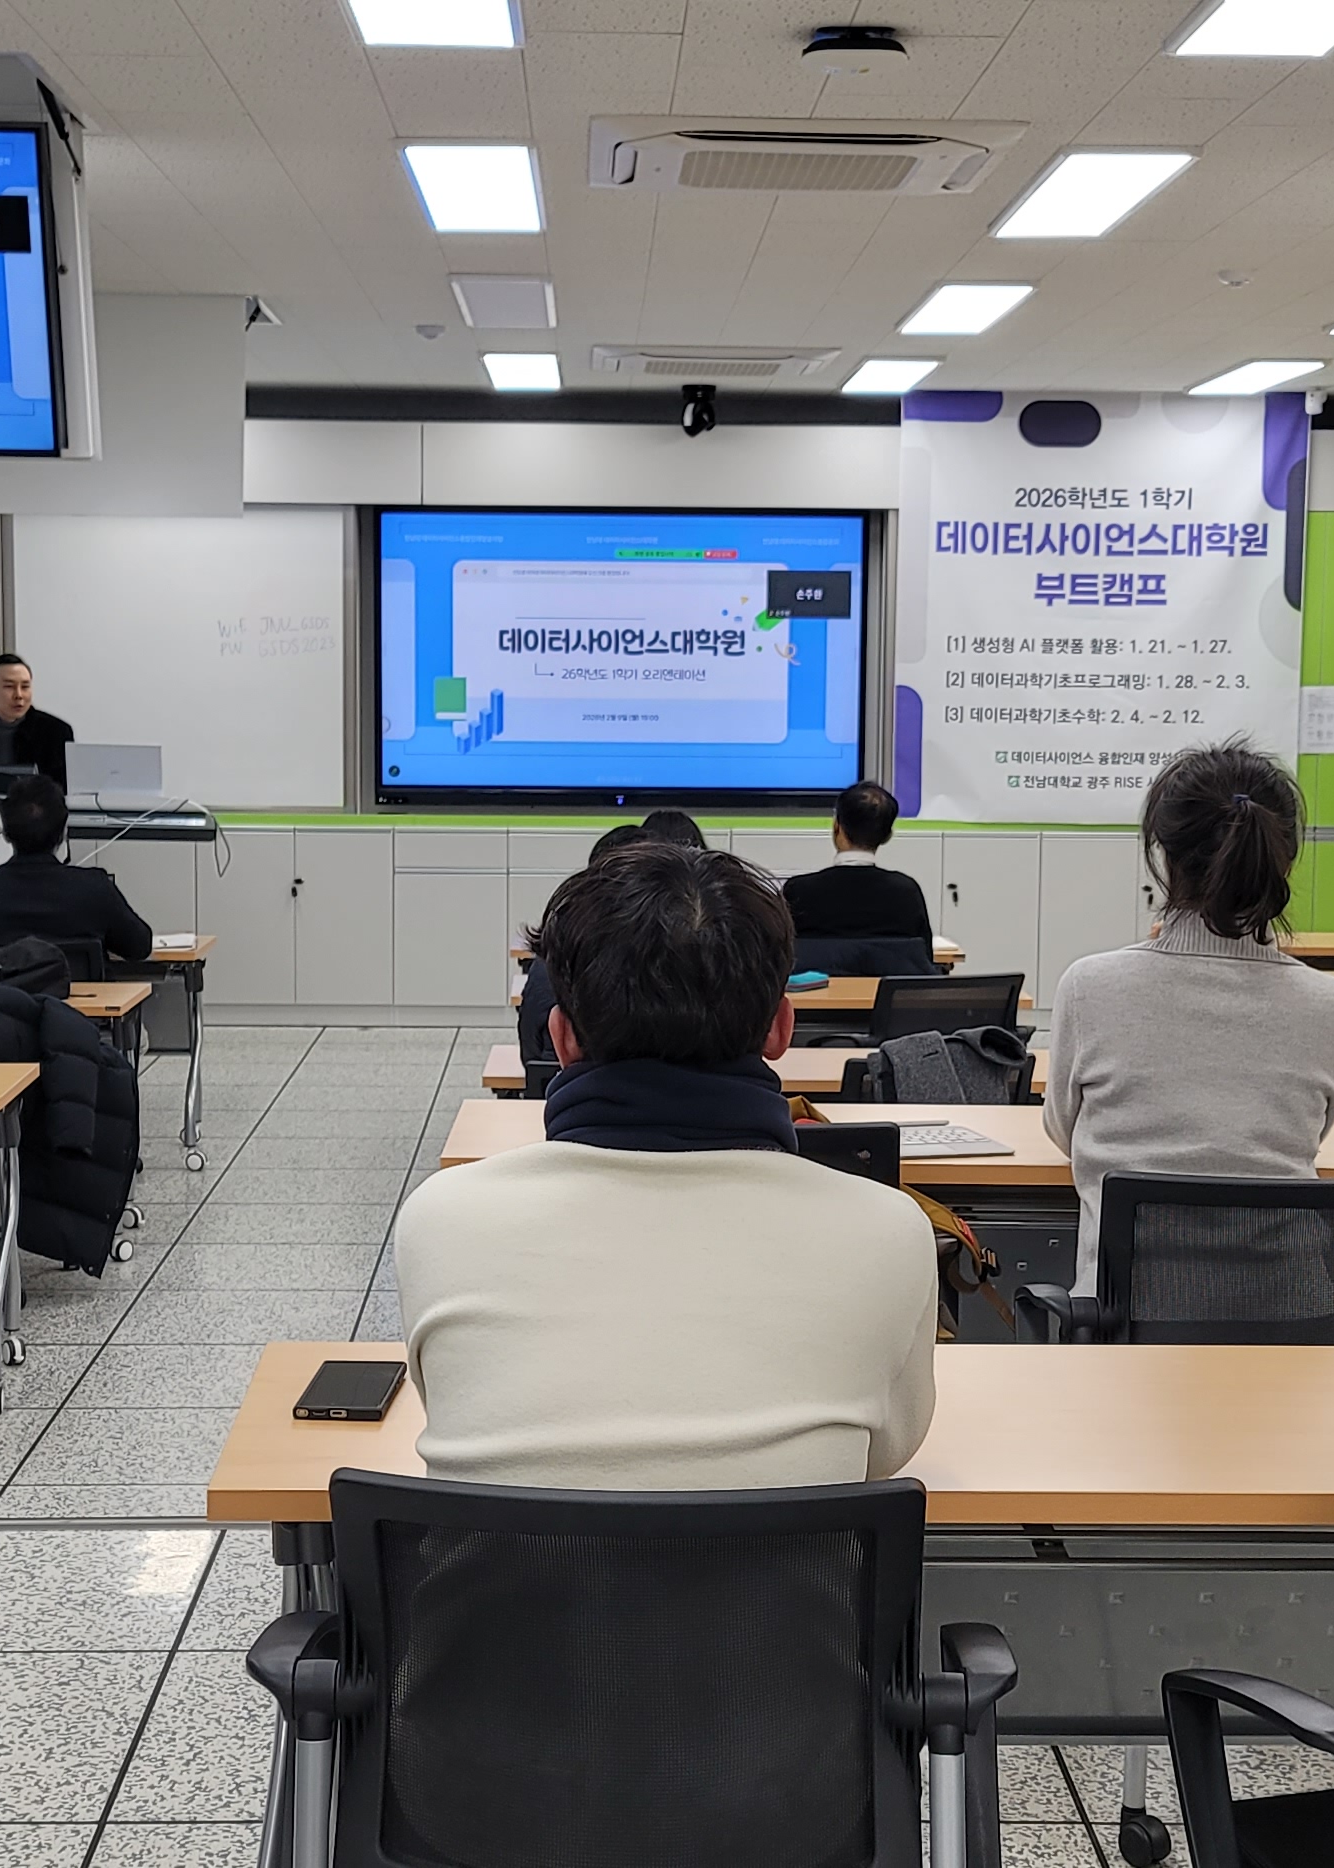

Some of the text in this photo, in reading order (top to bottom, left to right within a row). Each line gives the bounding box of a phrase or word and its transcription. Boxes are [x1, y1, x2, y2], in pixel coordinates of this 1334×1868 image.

[1014, 487, 1194, 510] 2026학년도 1학기
[935, 520, 1269, 558] 데이터사이언스대학원
[1033, 572, 1168, 607] 부트캠프
[498, 626, 746, 657] 데이터사이언스대학원
[947, 636, 966, 654] [1]
[971, 637, 1015, 655] 생성형
[1019, 639, 1035, 653] AI
[1040, 637, 1084, 655] 플랫폼
[1089, 637, 1124, 656] 활용:
[1130, 640, 1143, 654] 1.
[1148, 640, 1171, 654] 21.
[1192, 640, 1204, 654] 1.
[1209, 640, 1231, 654] 27.
[561, 667, 609, 682] 26학년도
[641, 667, 706, 683] 오리엔테이션
[945, 671, 965, 690] [2]
[971, 671, 1151, 691] 데이터과학기초프로그래밍:
[1157, 674, 1170, 689] 1.
[1175, 674, 1198, 689] 28.
[1216, 674, 1230, 689] 2.
[1235, 674, 1250, 689] 3.
[944, 706, 964, 724] [3]
[970, 706, 1105, 725] 데이터과학기초수학:
[1111, 709, 1126, 724] 2.
[1130, 709, 1144, 724] 4.
[1163, 709, 1177, 724] 2.
[1182, 709, 1205, 724] 12.
[1012, 751, 1094, 765] 데이터사이언스
[1098, 752, 1145, 766] 융합인재
[1023, 776, 1083, 789] 전남대학교
[1087, 776, 1111, 789] 광주
[1114, 776, 1143, 788] RISE
